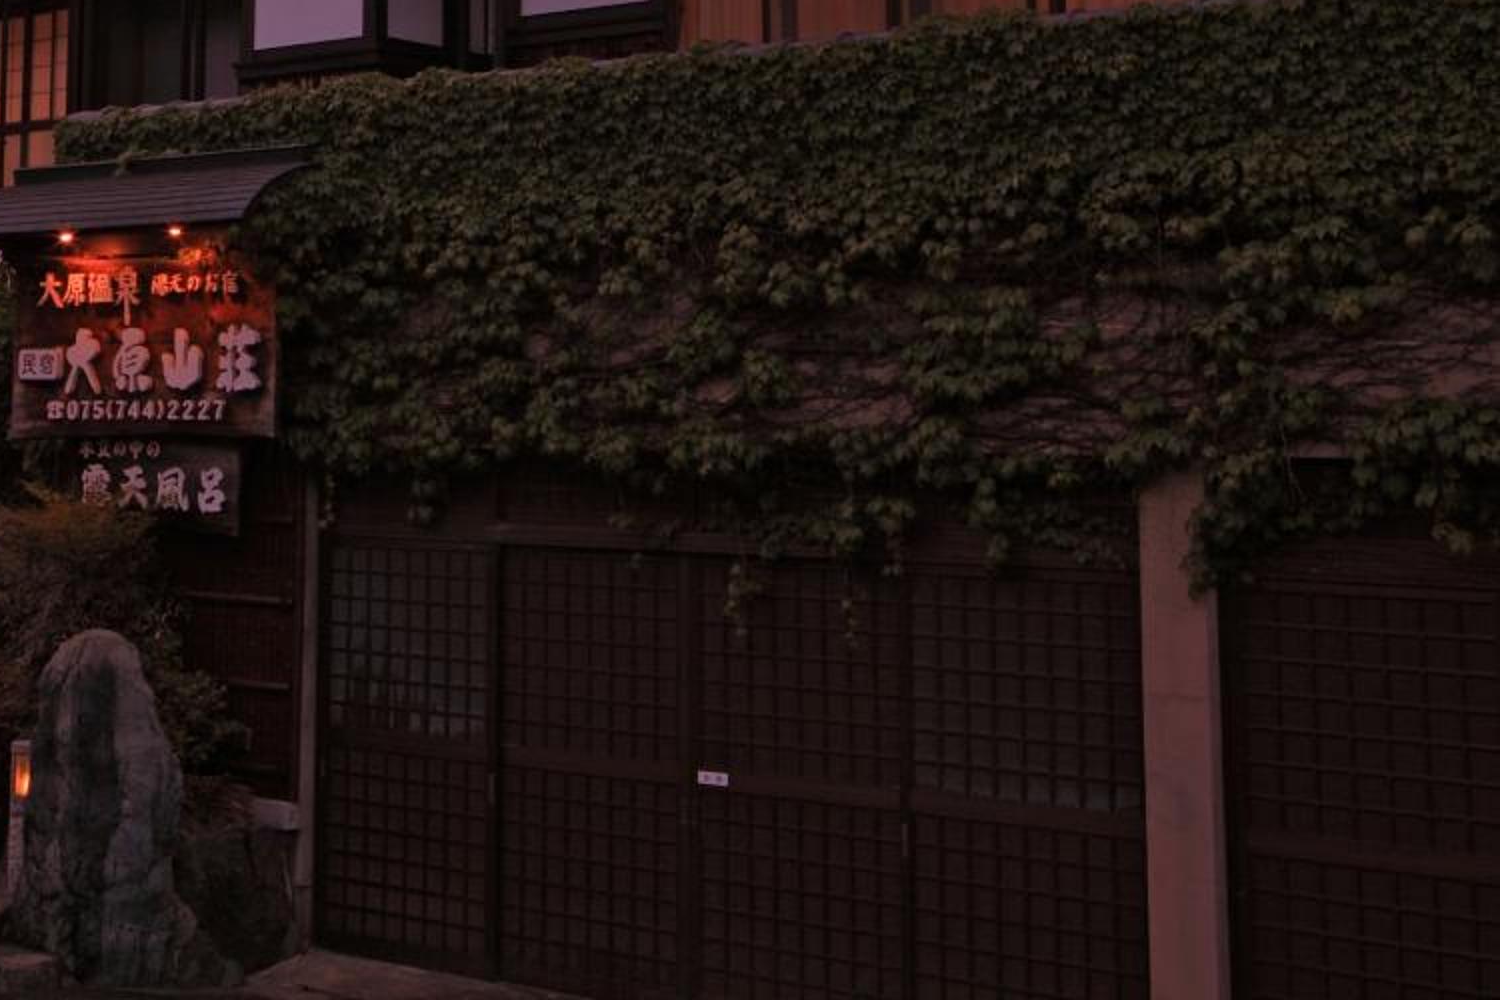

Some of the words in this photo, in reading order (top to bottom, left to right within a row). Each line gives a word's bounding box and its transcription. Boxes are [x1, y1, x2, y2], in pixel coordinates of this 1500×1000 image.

[37, 265, 140, 325] 大原温泉
[64, 324, 262, 394] 大原山荘
[66, 399, 227, 422] 075(744)2227
[80, 463, 226, 513] 露天風呂
